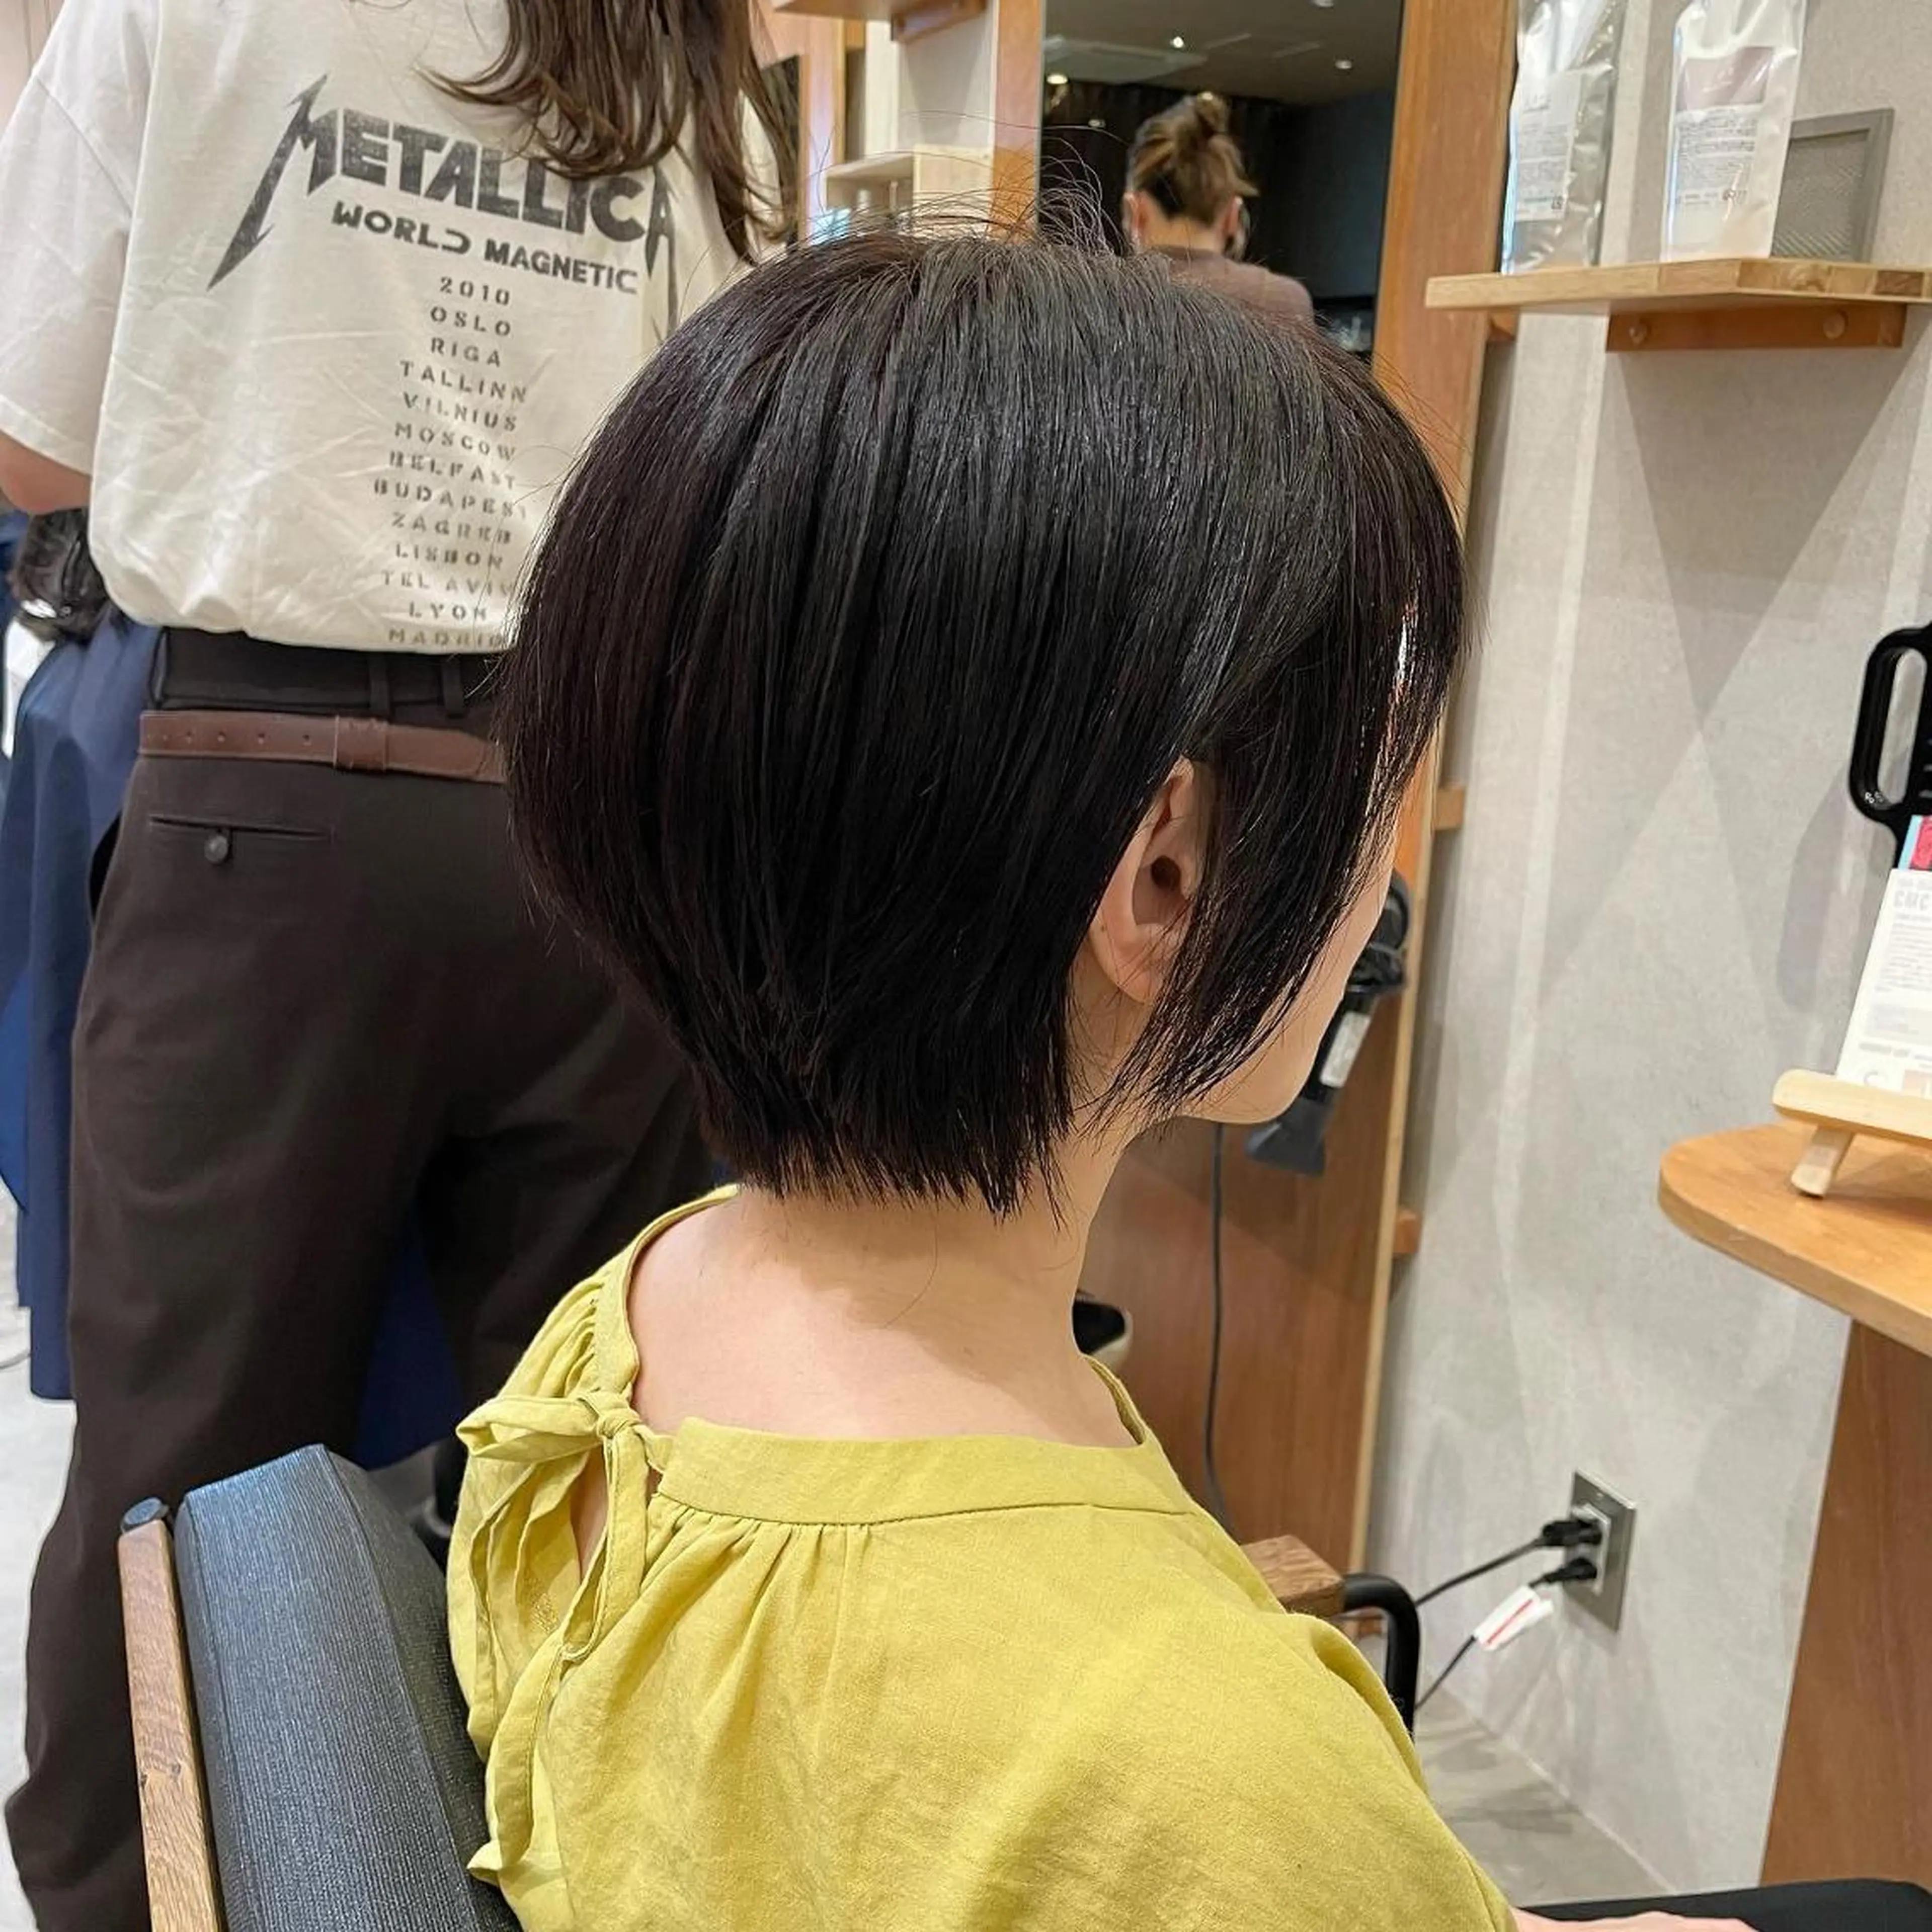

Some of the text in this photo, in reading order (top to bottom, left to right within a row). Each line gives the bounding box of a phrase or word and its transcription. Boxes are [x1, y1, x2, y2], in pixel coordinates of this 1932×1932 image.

[206, 73, 679, 338] METALLICA
[484, 237, 638, 295] MAGNETIC
[439, 276, 510, 306] 2010
[430, 306, 511, 336] OSLO
[431, 337, 500, 367] RIGA
[400, 360, 527, 404] TALLINN
[403, 391, 518, 432] VILNIUS
[394, 422, 517, 462] MOSCOW
[389, 450, 515, 490] BELFAST
[391, 511, 511, 544] ZAGREB
[395, 542, 503, 570] LISBON
[381, 570, 430, 589] TEL
[409, 601, 487, 621] LYON
